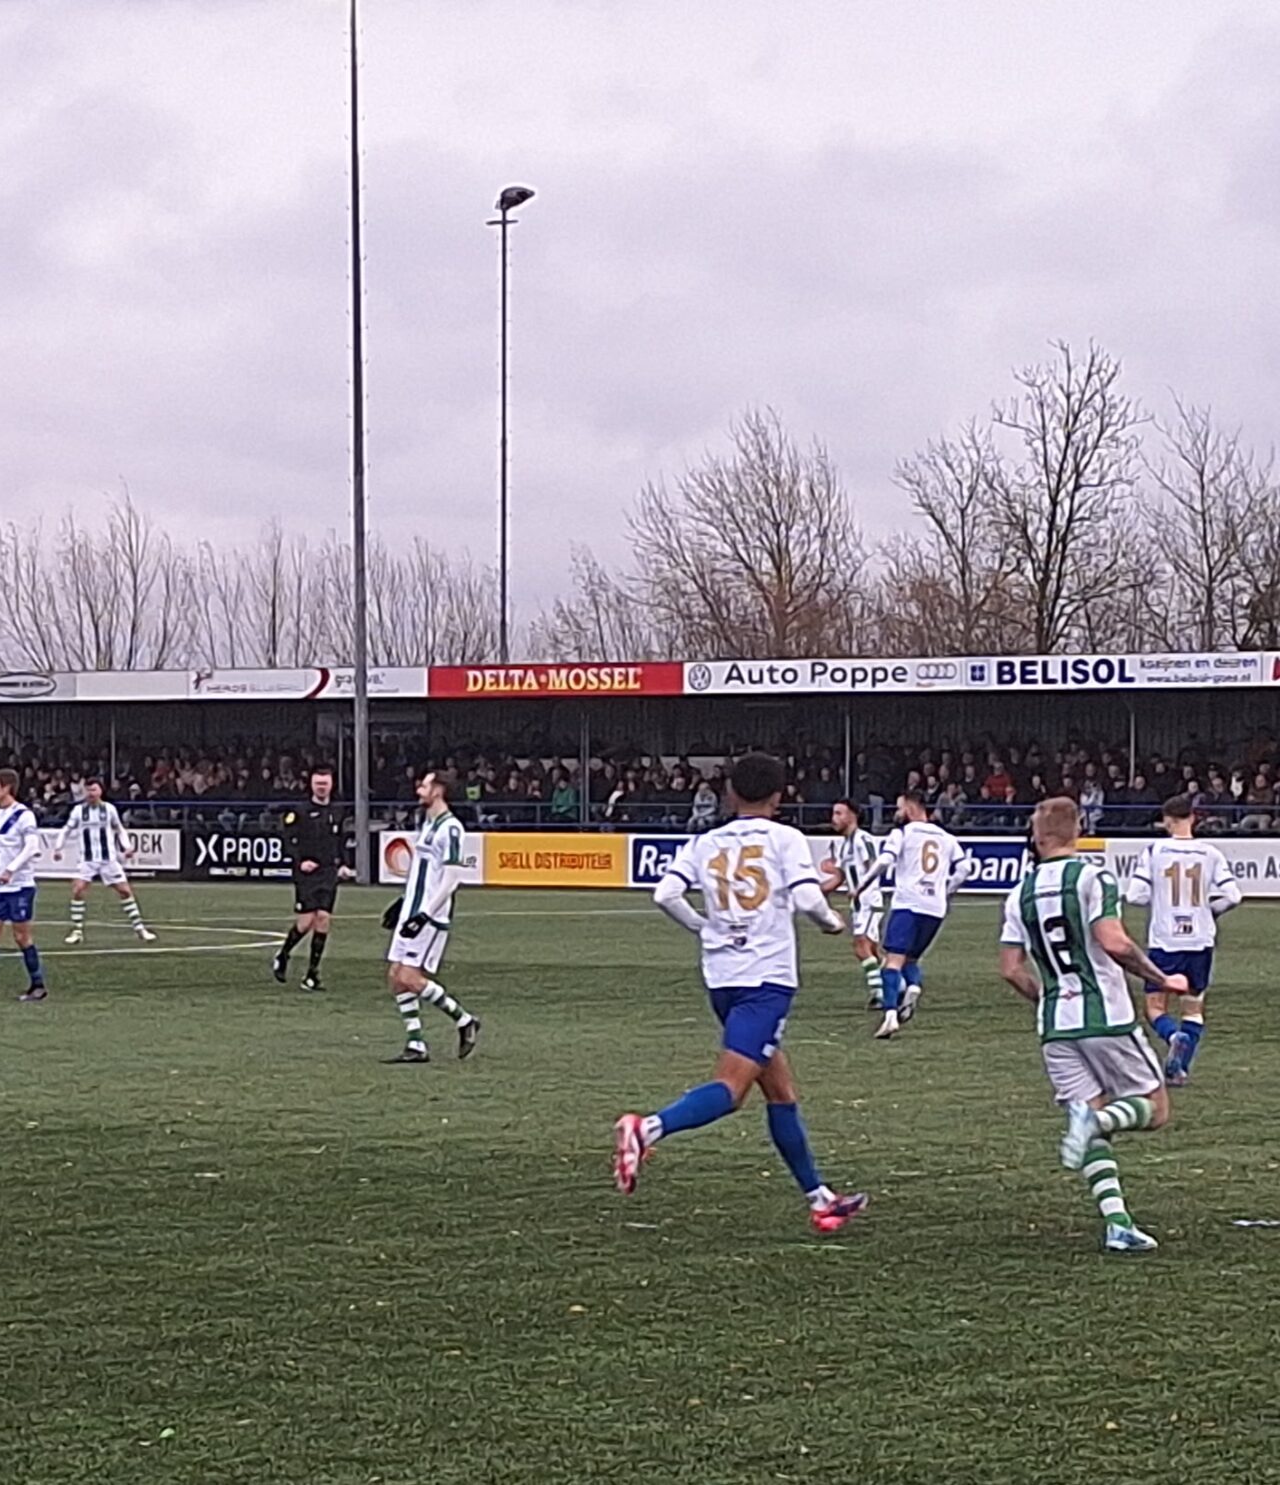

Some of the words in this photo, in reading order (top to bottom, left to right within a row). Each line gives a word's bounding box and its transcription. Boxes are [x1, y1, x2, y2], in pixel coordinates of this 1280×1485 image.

[724, 663, 799, 684] Auto
[810, 662, 909, 687] Poppe
[996, 659, 1135, 684] BELISOL
[499, 852, 531, 869] SHELL
[922, 840, 939, 875] 6
[707, 845, 770, 911] 15
[1164, 861, 1202, 907] 11
